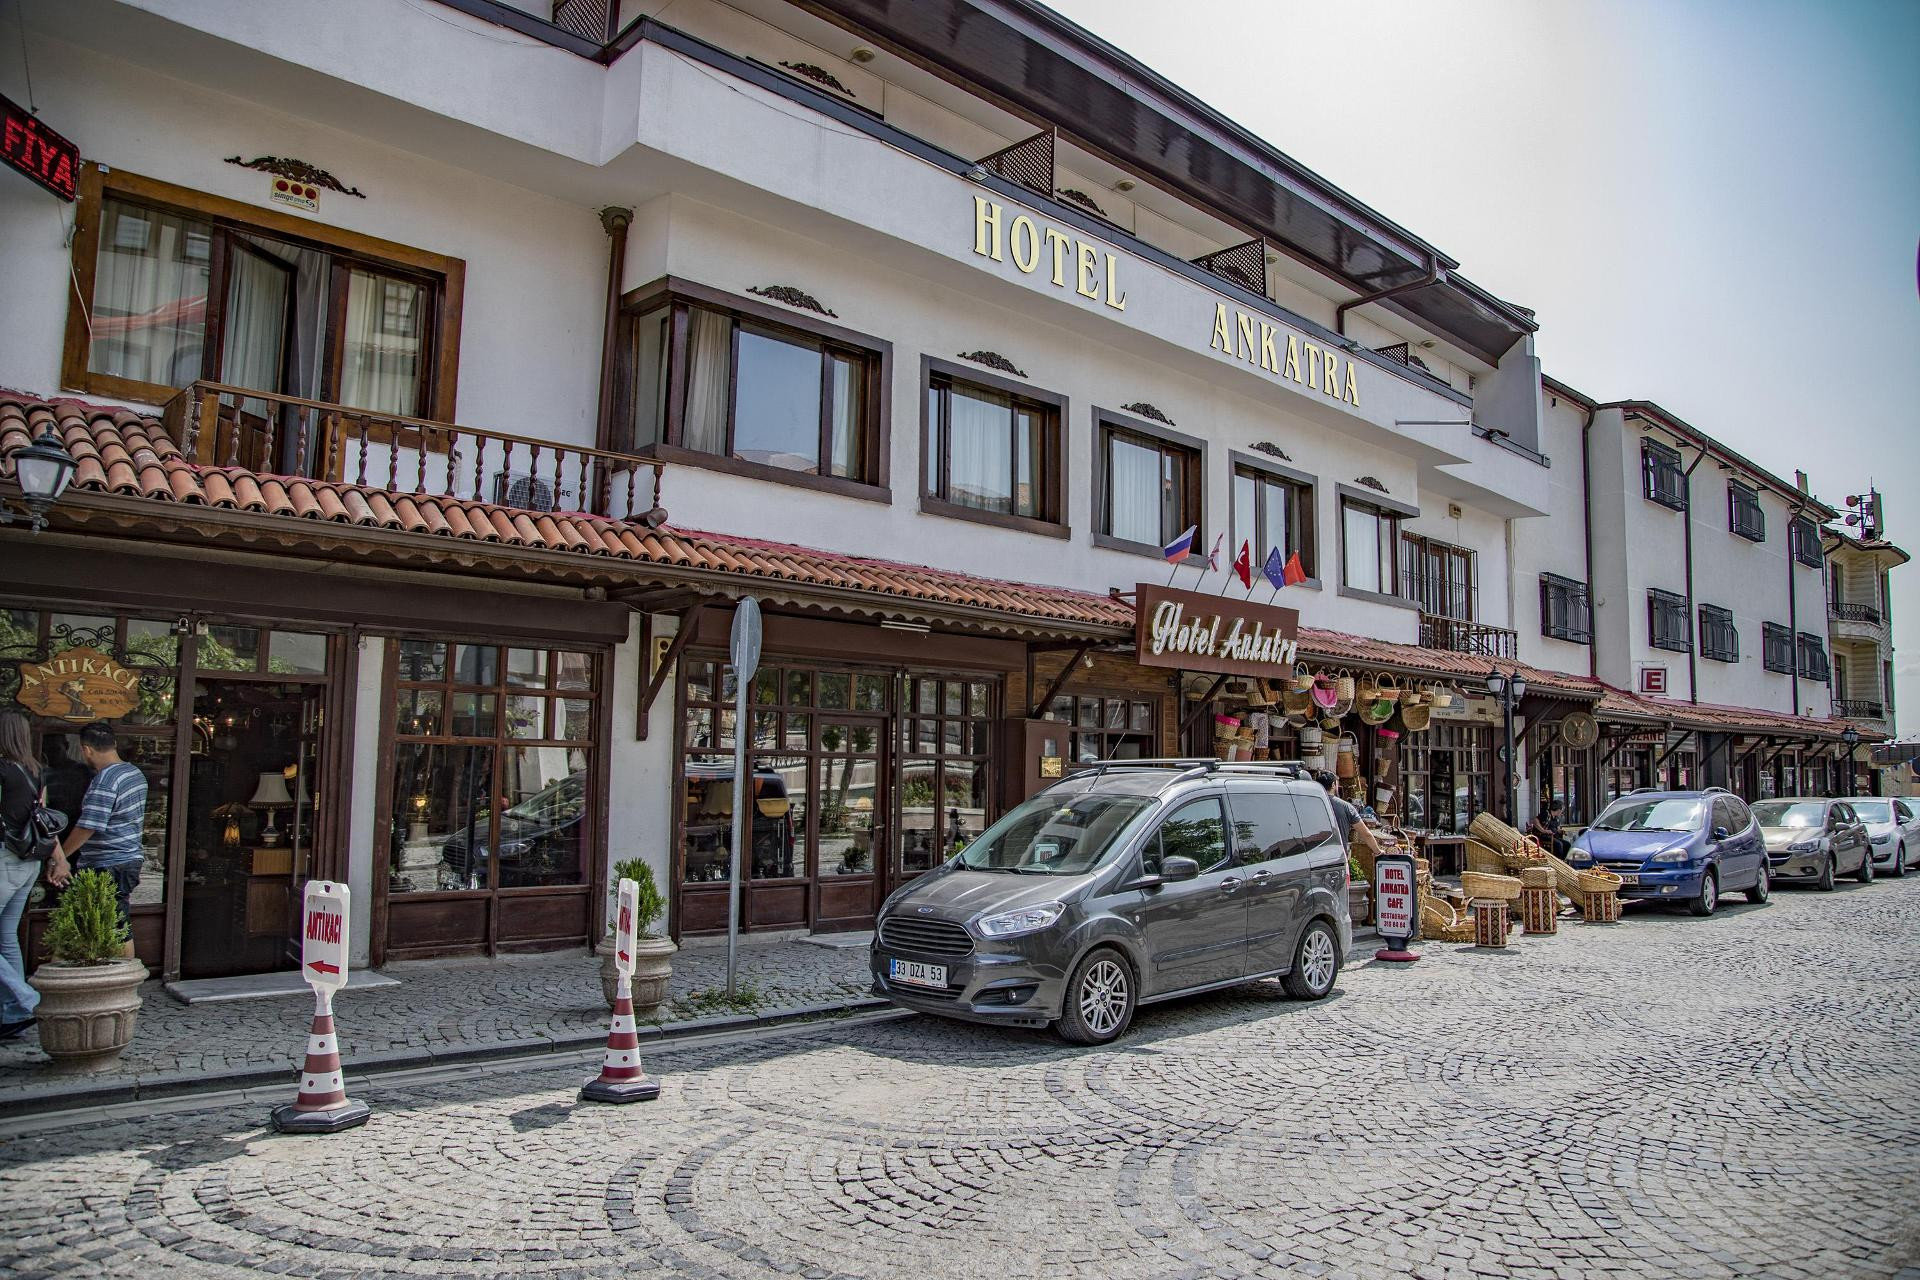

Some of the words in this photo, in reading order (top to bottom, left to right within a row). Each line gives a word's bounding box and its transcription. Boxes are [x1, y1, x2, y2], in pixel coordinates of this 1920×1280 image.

[973, 195, 1126, 312] HOTEL
[1210, 302, 1360, 408] ANKATRA
[1152, 600, 1221, 656] Hotel
[1219, 617, 1297, 665] Ankatra
[24, 658, 138, 689] ANTIKACI
[1646, 672, 1661, 689] E
[1384, 869, 1404, 880] HOTEL
[1380, 882, 1409, 895] ANKATRA
[1387, 897, 1403, 909] CAFE
[896, 961, 906, 975] 33
[910, 963, 925, 978] DZA
[930, 966, 942, 980] 53
